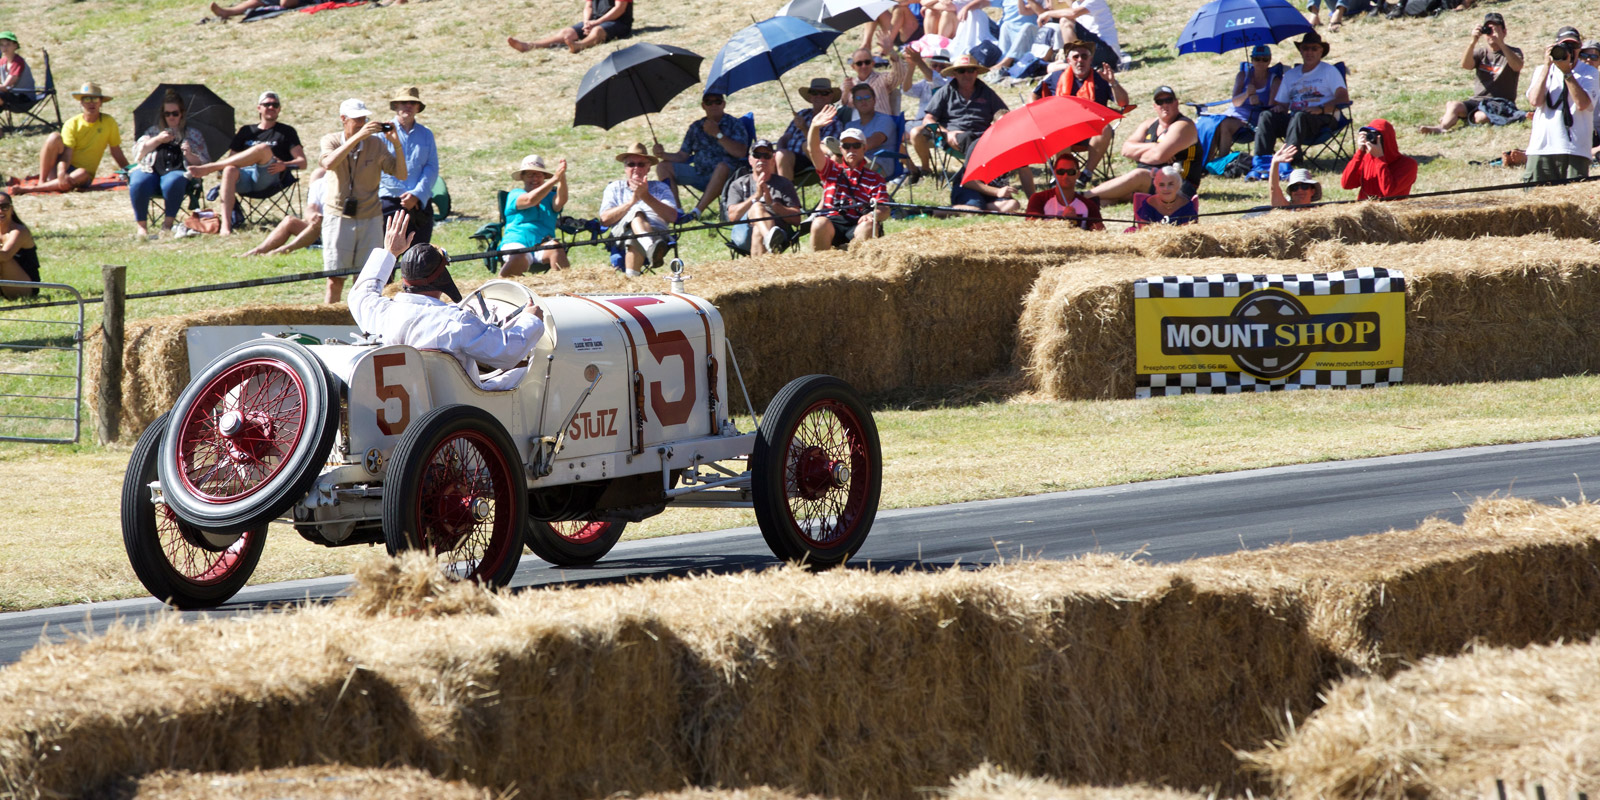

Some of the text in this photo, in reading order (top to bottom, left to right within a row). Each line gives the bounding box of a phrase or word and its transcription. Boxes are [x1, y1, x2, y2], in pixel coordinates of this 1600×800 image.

[1236, 16, 1256, 26] LIC
[1166, 321, 1376, 348] MOUNT SHOP
[604, 297, 697, 427] 5
[1315, 359, 1394, 368] www.mountshop.co.nz
[373, 352, 411, 436] 5
[569, 408, 618, 441] STUTZ
